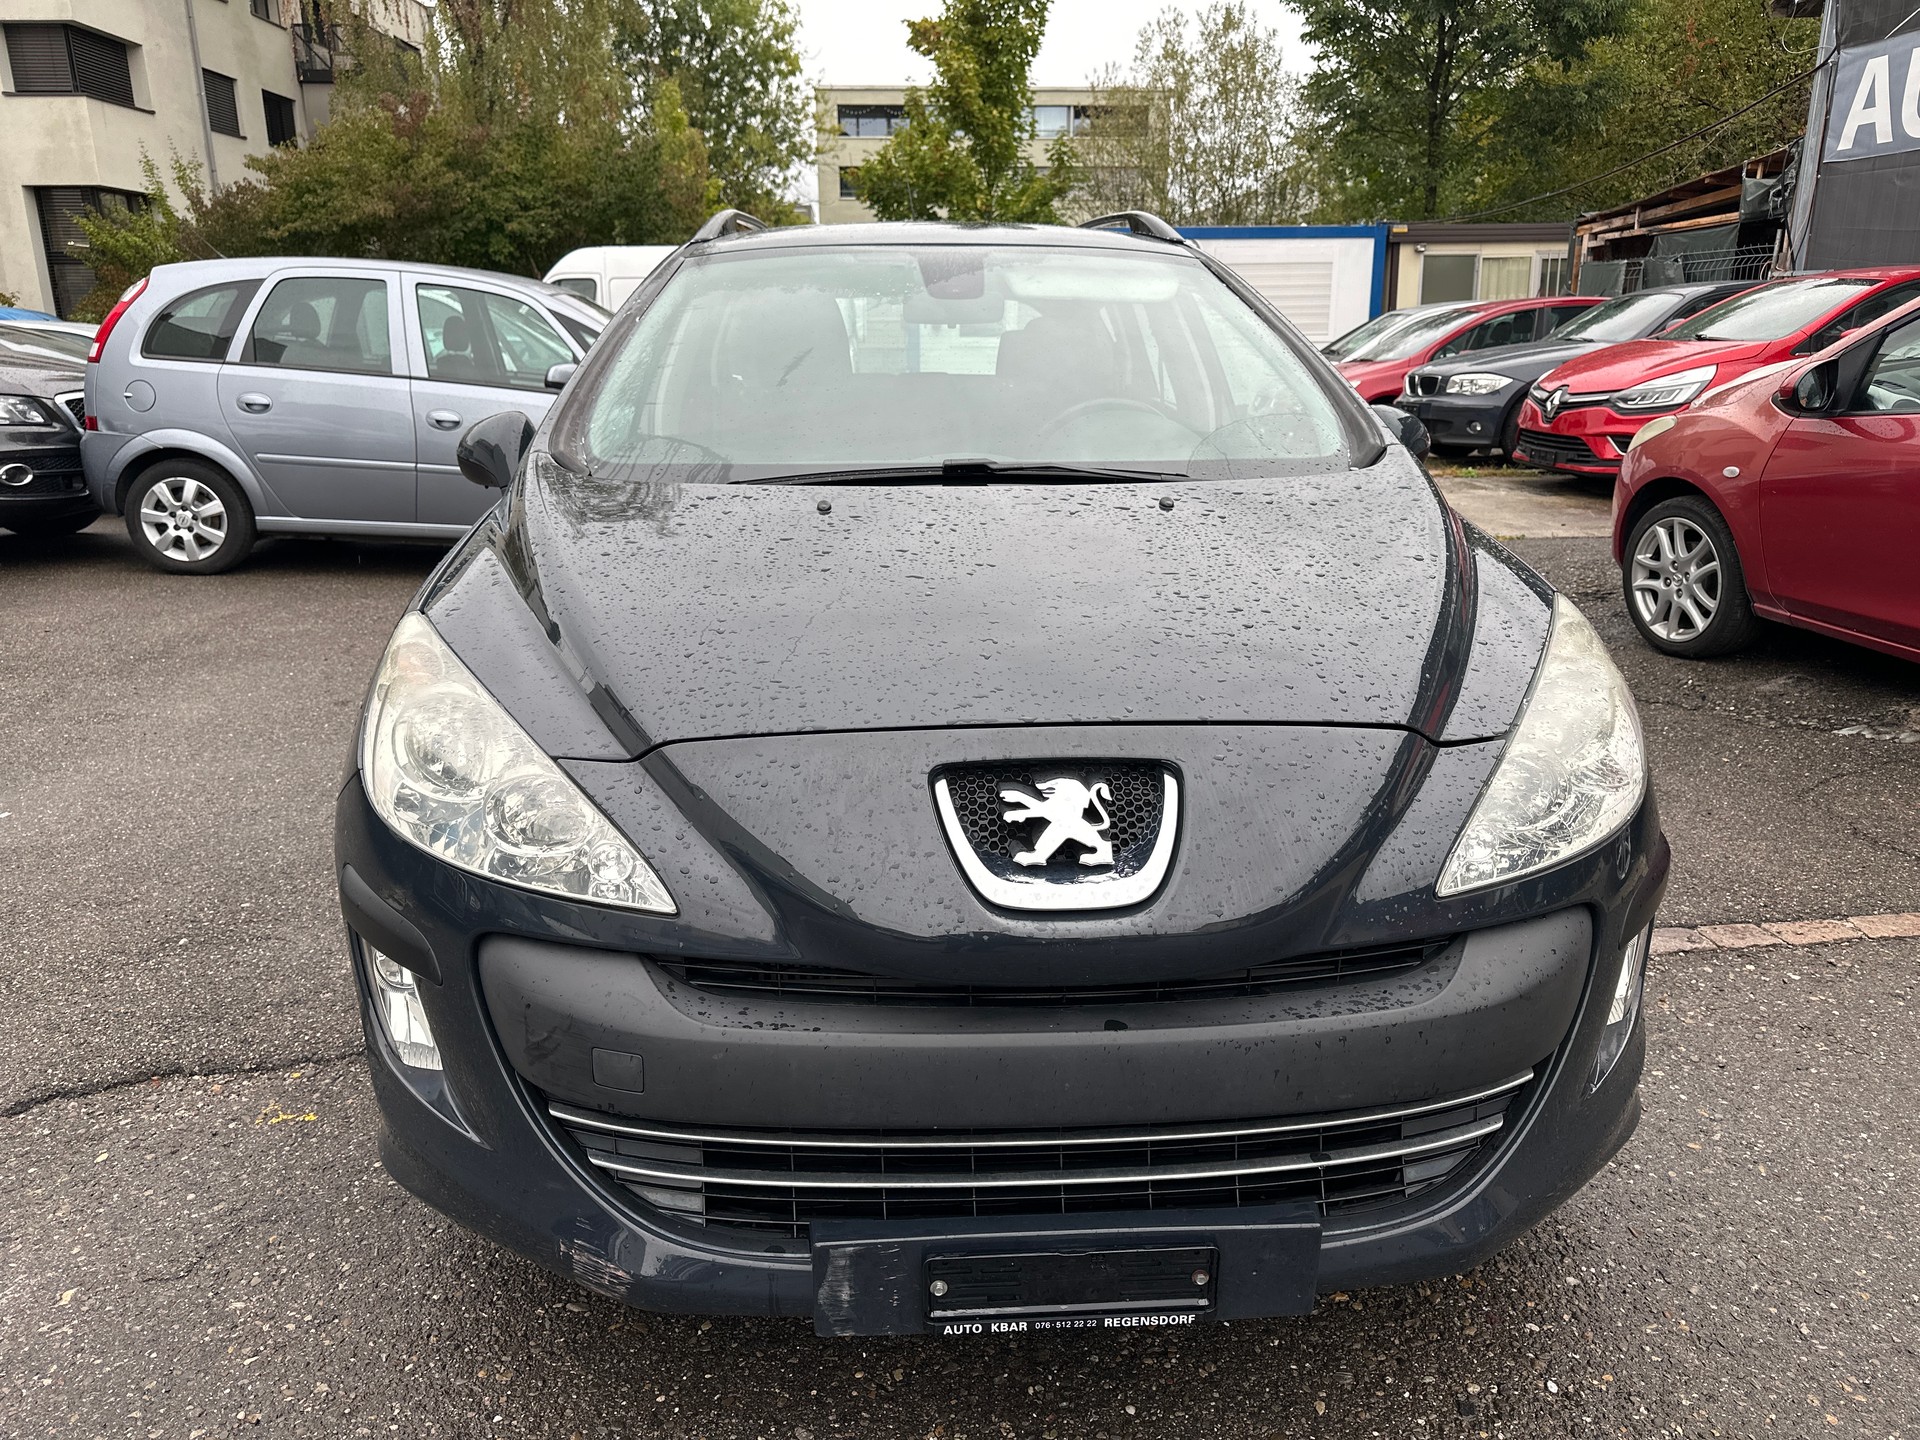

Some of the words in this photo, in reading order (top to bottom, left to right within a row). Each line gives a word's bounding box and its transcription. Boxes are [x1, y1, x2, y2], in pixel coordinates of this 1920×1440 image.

[943, 1324, 983, 1335] AUTO
[991, 1322, 1028, 1333] KBAR
[1104, 1314, 1196, 1328] REGENSDORF
